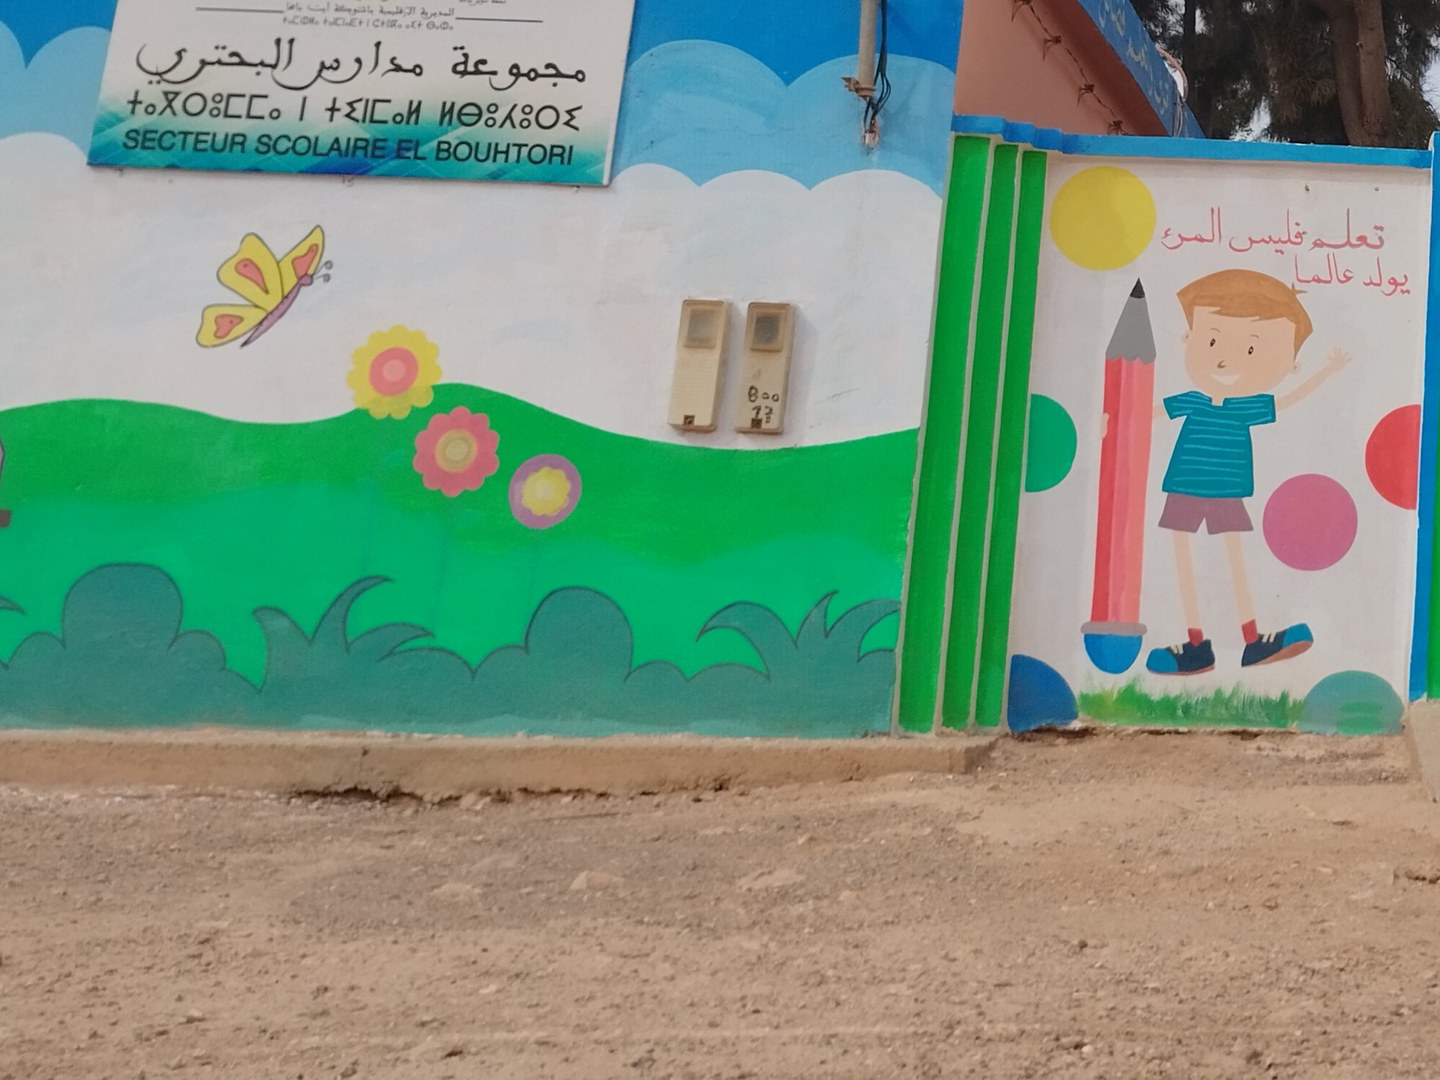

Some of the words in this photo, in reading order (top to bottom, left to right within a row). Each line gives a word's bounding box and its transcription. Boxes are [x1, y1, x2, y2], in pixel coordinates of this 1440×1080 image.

[136, 37, 295, 85] البحتري
[271, 40, 424, 91] مدارس
[450, 45, 586, 92] مجموعة
[122, 128, 248, 155] SECTEUR
[254, 133, 389, 160] SCOLAIRE
[394, 138, 427, 162] EL
[435, 140, 574, 166] BOUHTORI
[1229, 208, 1305, 255] فليس
[1310, 207, 1385, 251] تعلم
[1293, 252, 1354, 285] عالما
[1362, 256, 1412, 296] يولد
